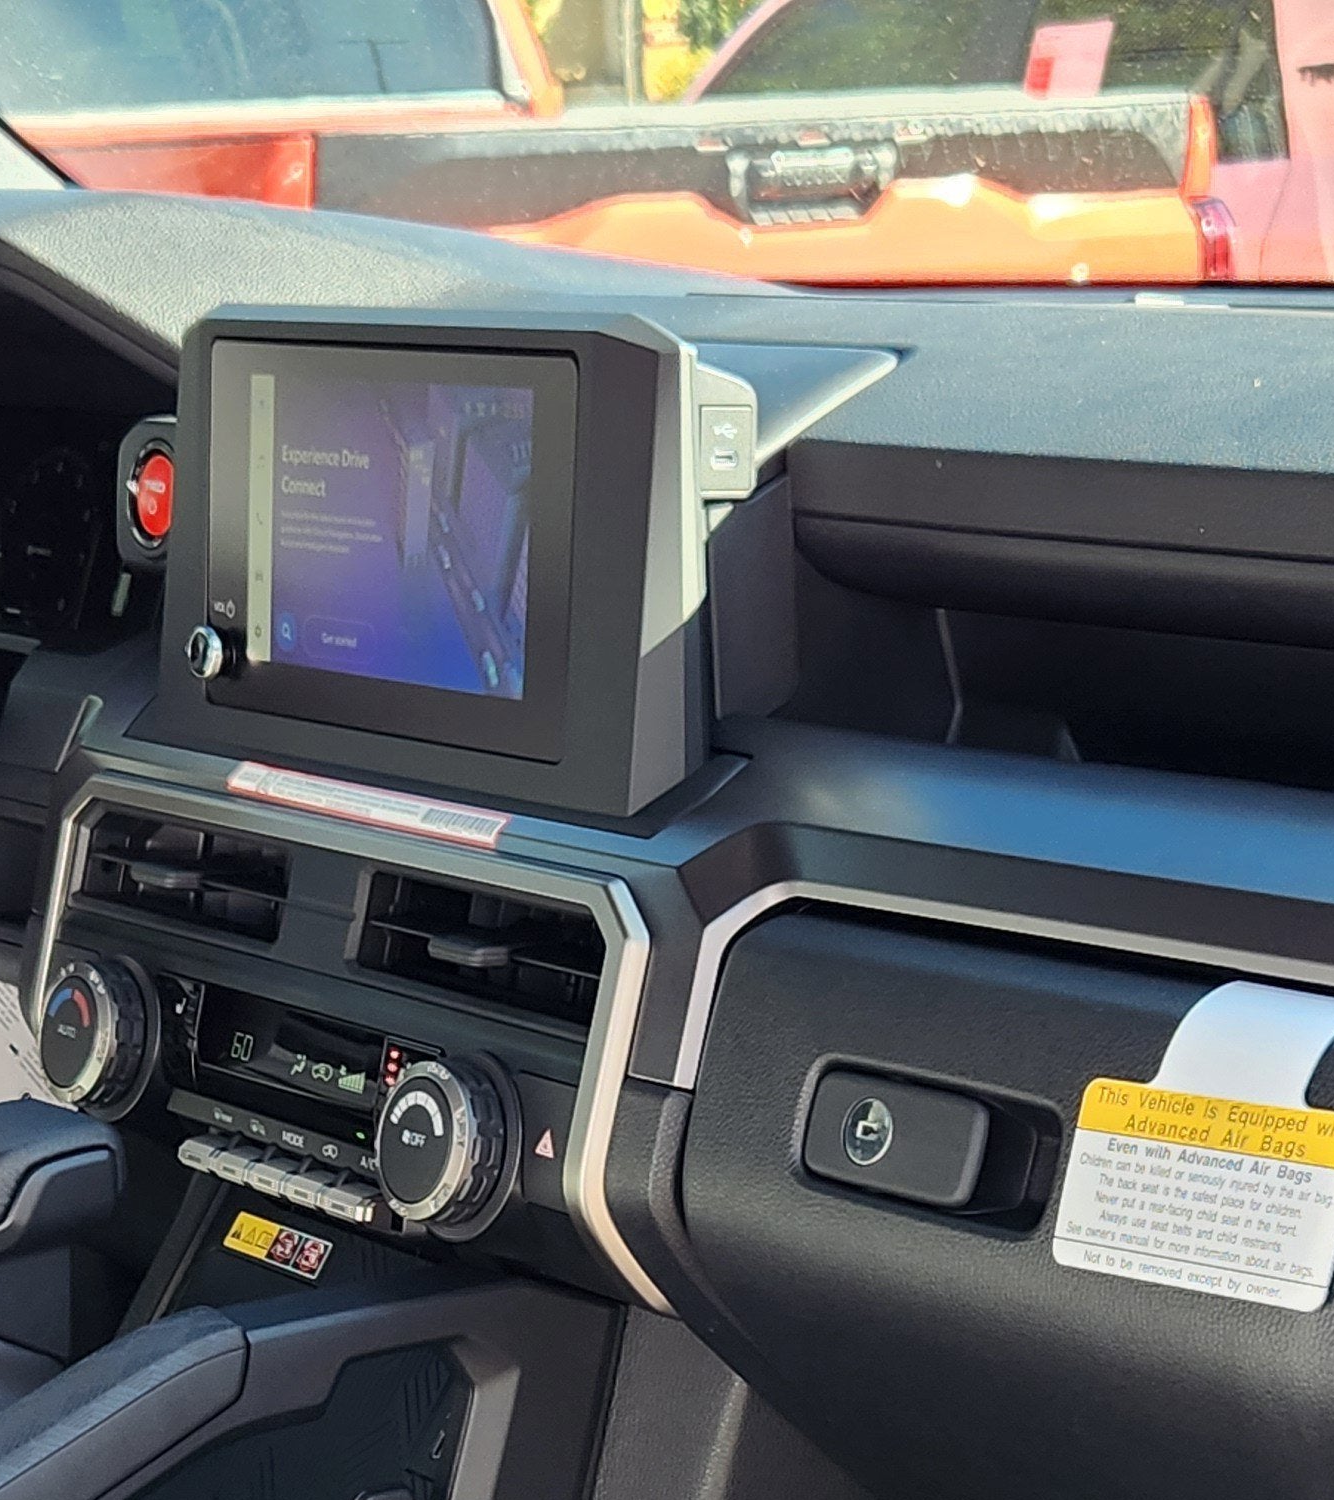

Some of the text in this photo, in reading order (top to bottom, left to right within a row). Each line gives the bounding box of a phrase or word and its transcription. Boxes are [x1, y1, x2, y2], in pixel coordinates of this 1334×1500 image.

[342, 449, 370, 469] Drive
[281, 476, 326, 497] Connect
[231, 1031, 254, 1061] 60
[1098, 1086, 1129, 1106] This
[1139, 1091, 1195, 1115] Vehicle
[1228, 1105, 1308, 1132] Equipped
[281, 1130, 305, 1148] MODE
[410, 1133, 427, 1148] OFF
[1125, 1114, 1307, 1158] Advanced Air Bags
[1079, 1152, 1113, 1169] Children
[1134, 1162, 1146, 1175] be
[1263, 1184, 1276, 1198] by
[1107, 1137, 1313, 1185] Even with Advanced Air Bags
[1099, 1173, 1114, 1187] The
[1083, 1249, 1101, 1264] Not
[1106, 1254, 1115, 1267] to
[1120, 1257, 1133, 1270] be
[1139, 1263, 1183, 1279] removed
[1227, 1277, 1241, 1293] by
